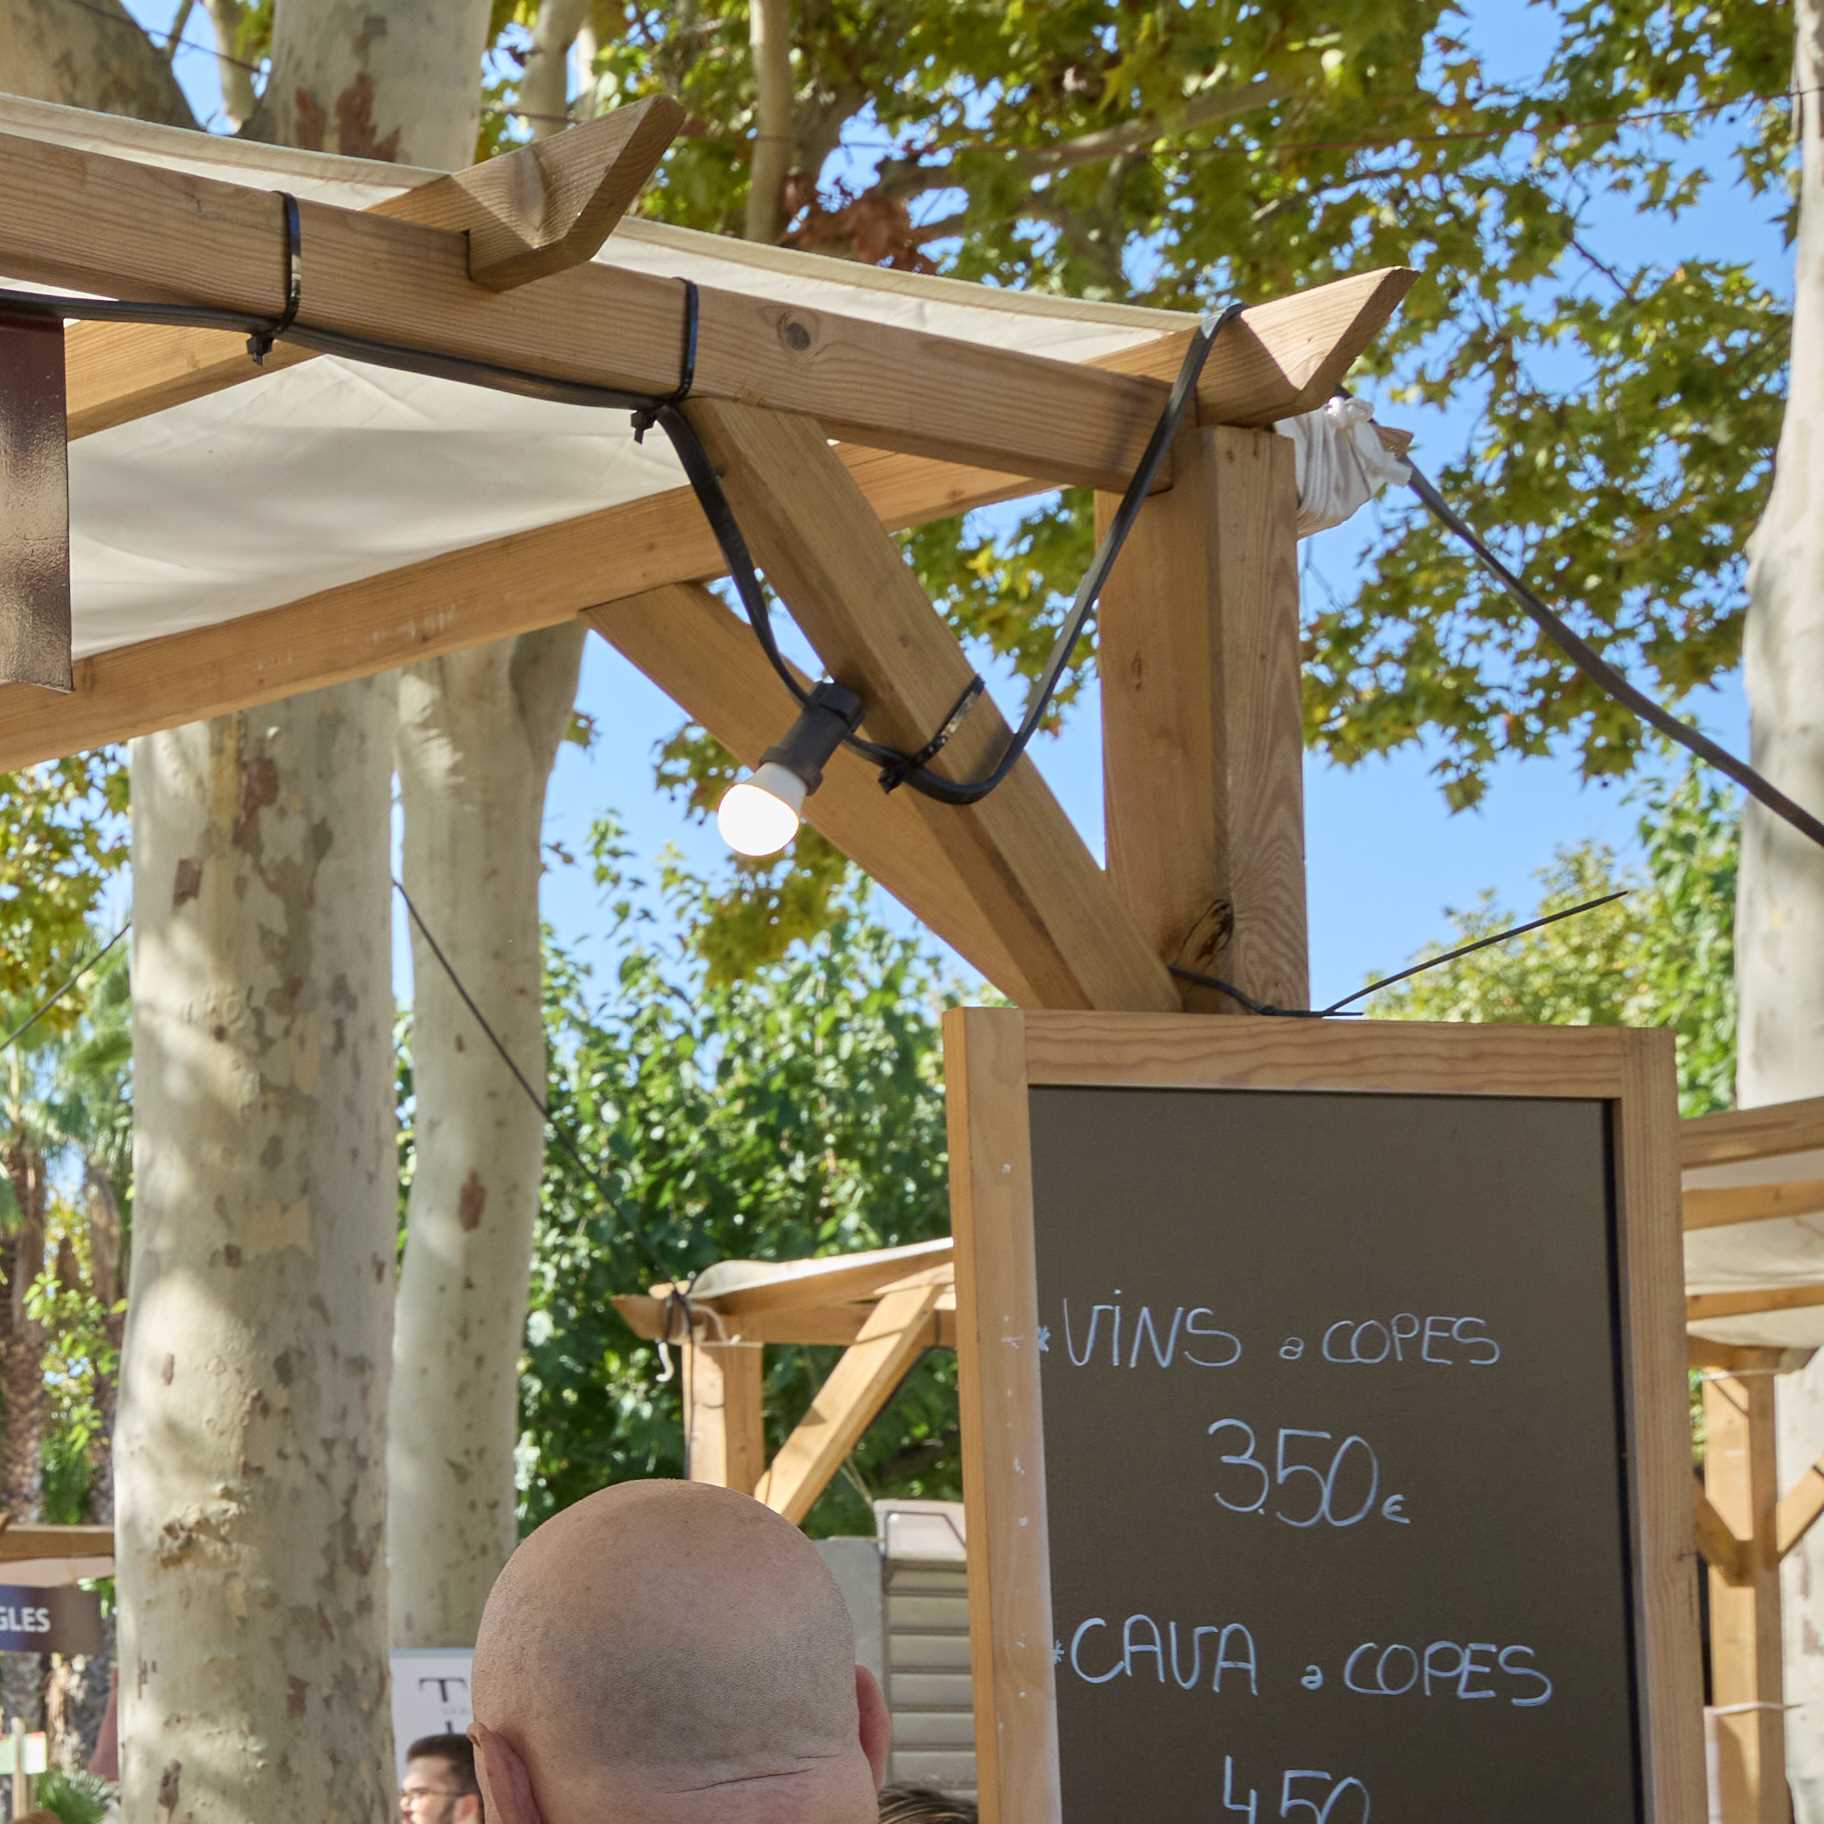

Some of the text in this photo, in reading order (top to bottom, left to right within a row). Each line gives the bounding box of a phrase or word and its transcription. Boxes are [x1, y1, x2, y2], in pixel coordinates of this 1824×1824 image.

[1279, 1336, 1305, 1360] a
[1322, 1312, 1501, 1366] COPES
[1070, 1614, 1554, 1706] CAVA a COPES
